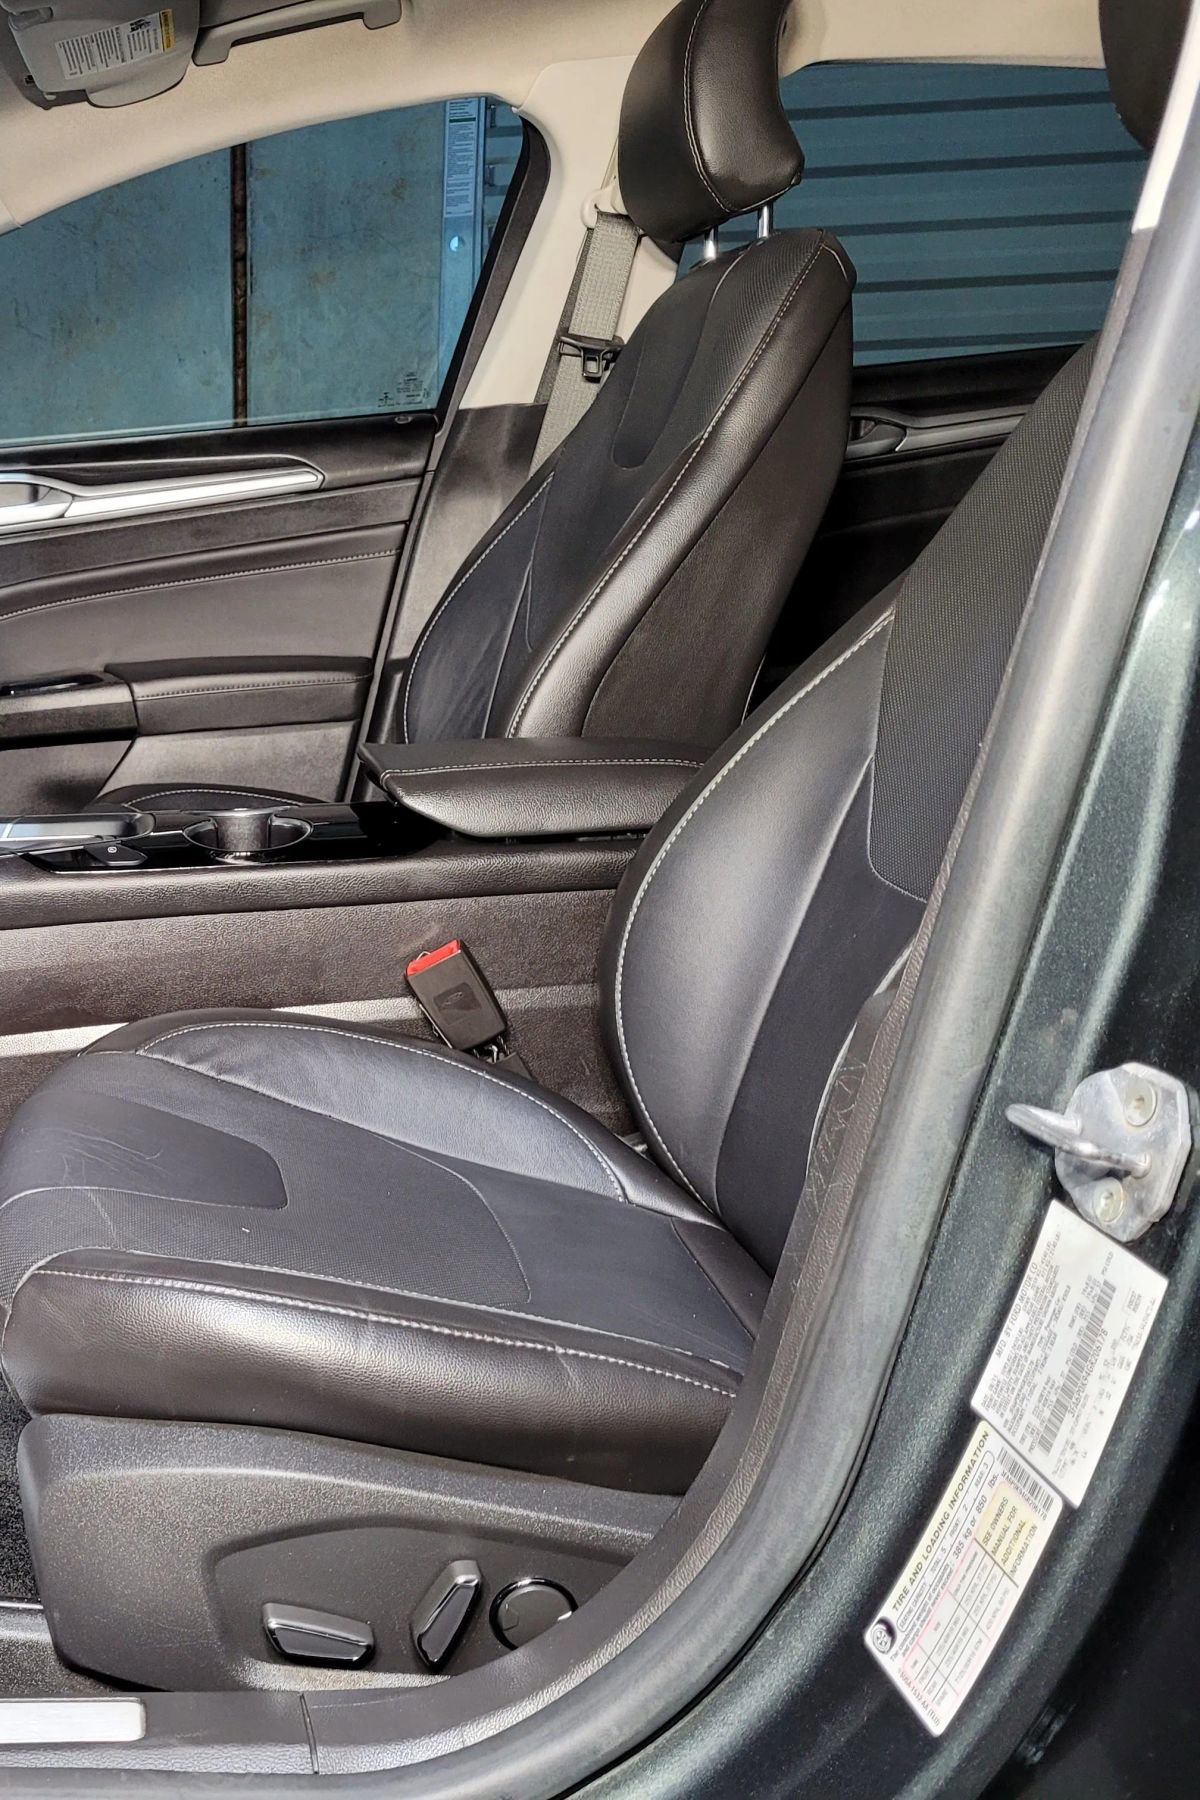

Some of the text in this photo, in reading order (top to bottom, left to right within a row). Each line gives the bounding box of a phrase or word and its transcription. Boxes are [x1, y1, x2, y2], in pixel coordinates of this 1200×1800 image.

[1003, 1324, 1013, 1338] BY
[1008, 1301, 1022, 1326] FORD
[1016, 1272, 1034, 1304] MOTOR
[891, 1428, 990, 1614] TIRE AND LOADING INFORMATION
[951, 1538, 966, 1561] 385
[974, 1492, 988, 1515] 850
[981, 1495, 1009, 1547] SEE OWNERS
[990, 1504, 1019, 1557] MANUAL FOR
[999, 1517, 1027, 1567] ADDITIONAL
[1008, 1522, 1038, 1579] INFORMATION
